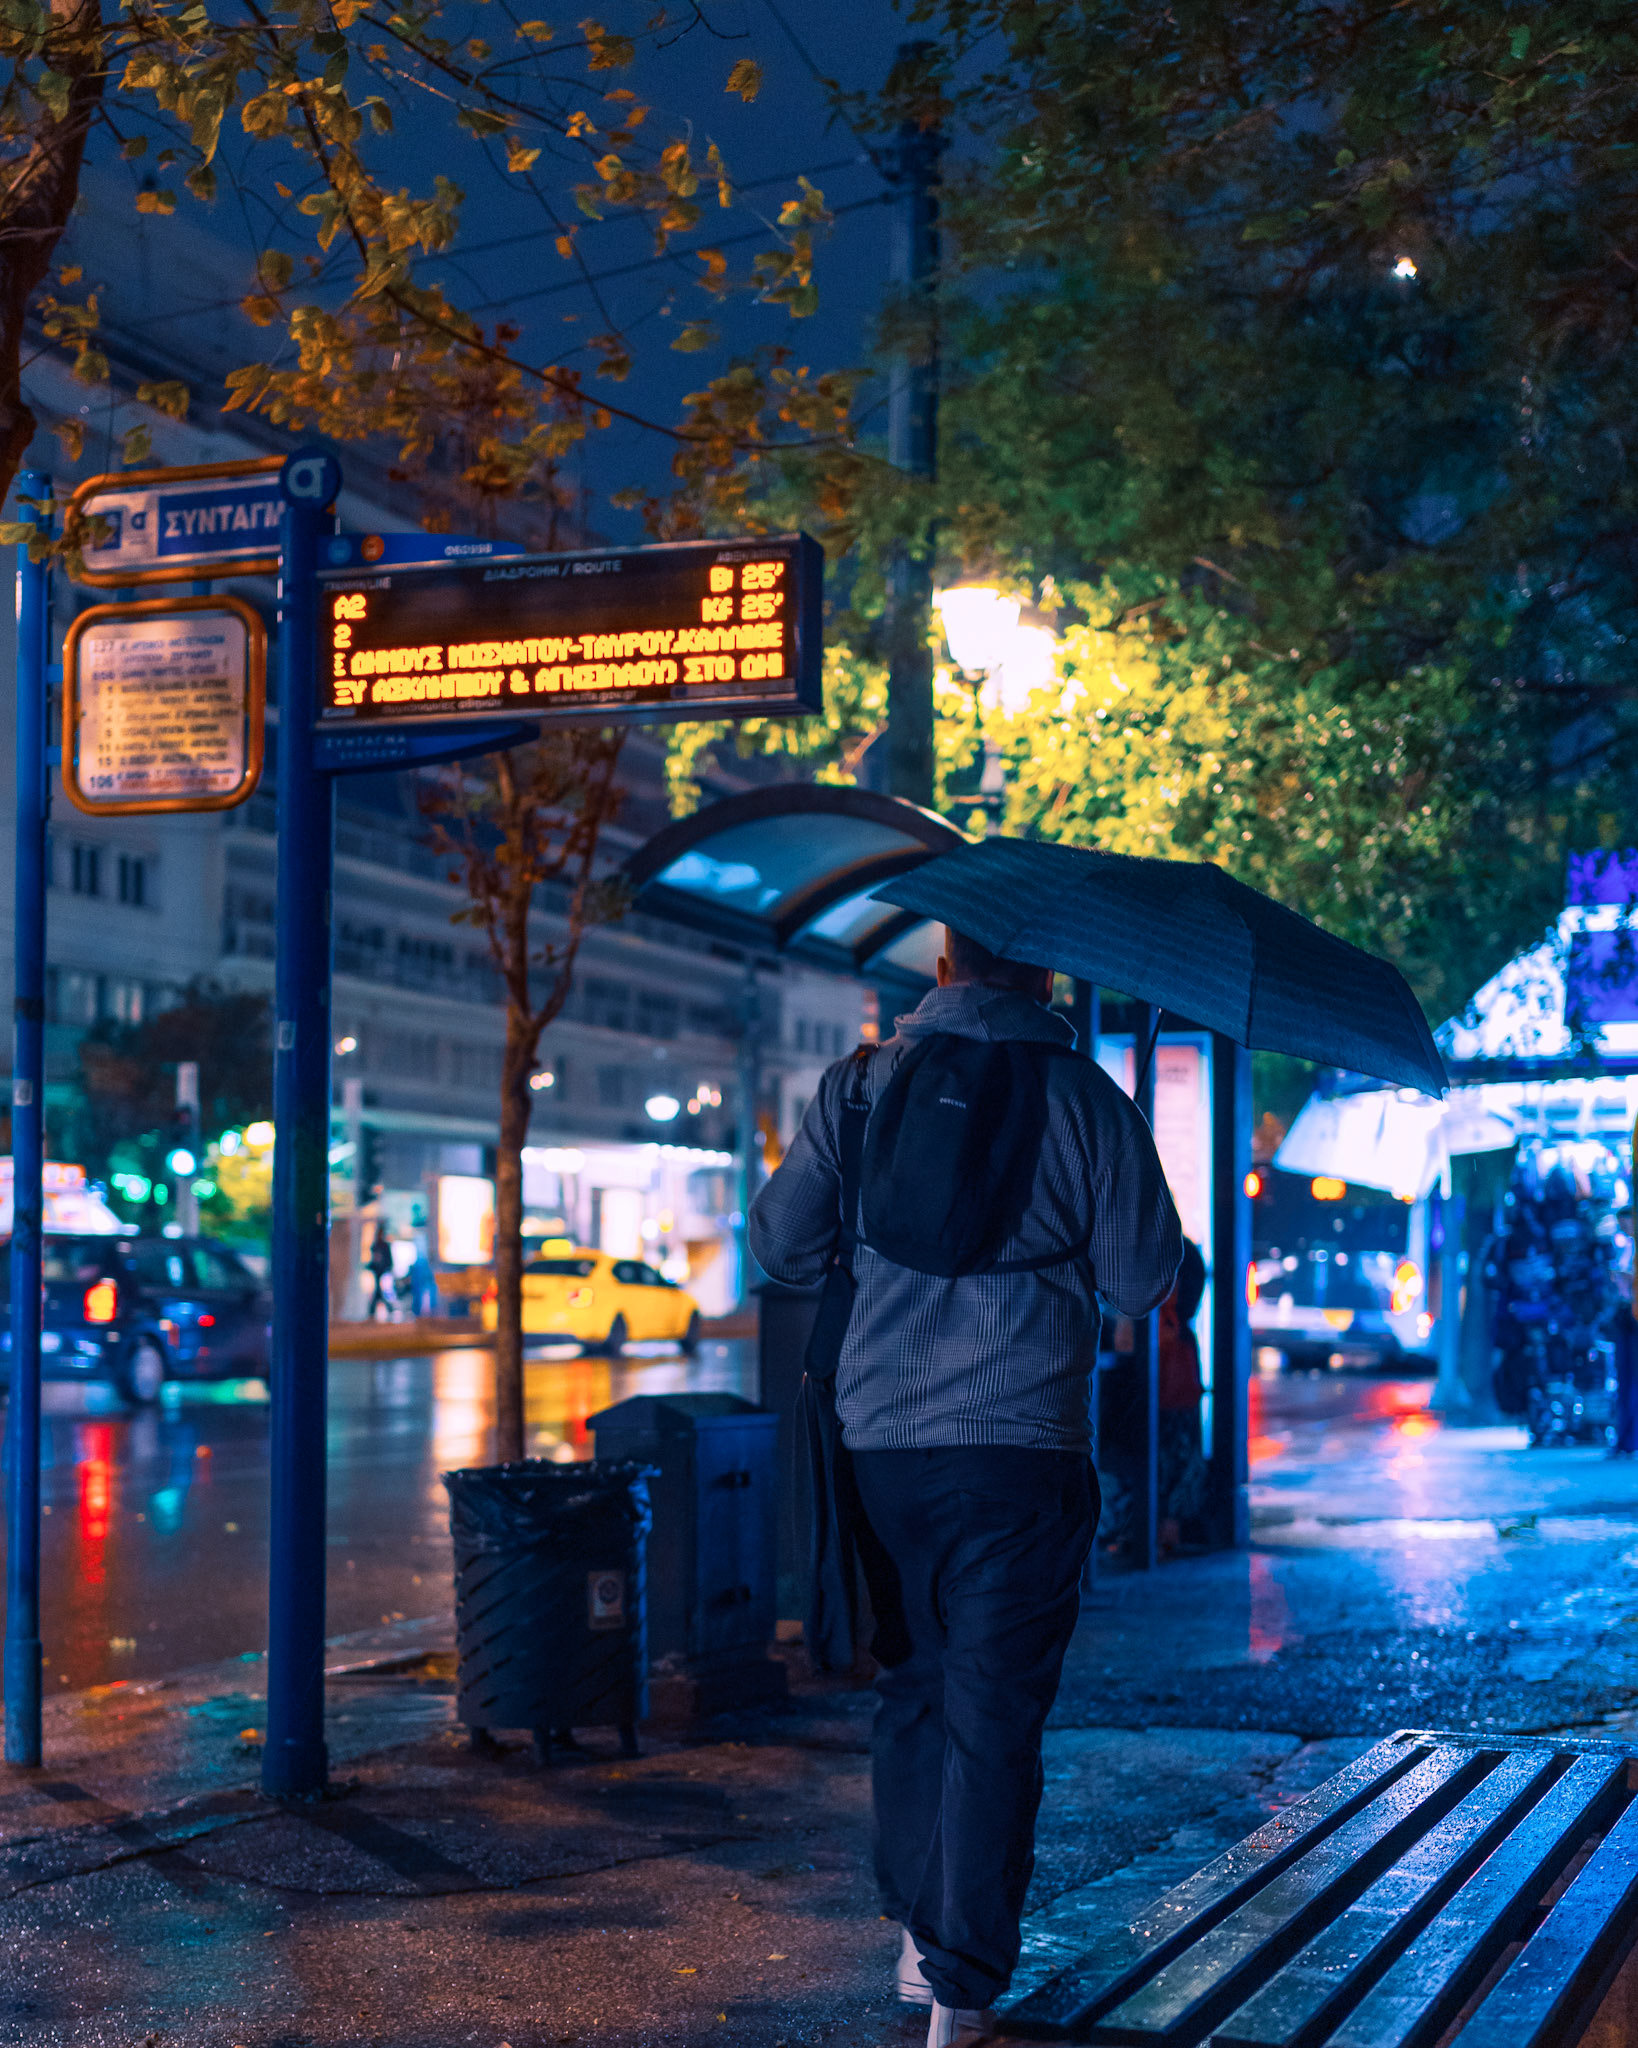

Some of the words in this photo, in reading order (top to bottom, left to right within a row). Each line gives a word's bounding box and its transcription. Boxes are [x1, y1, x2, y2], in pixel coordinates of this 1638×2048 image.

[572, 560, 622, 575] ROUTE
[334, 624, 351, 648] 2
[510, 670, 529, 693] &
[684, 656, 735, 682] ΣΤΟ
